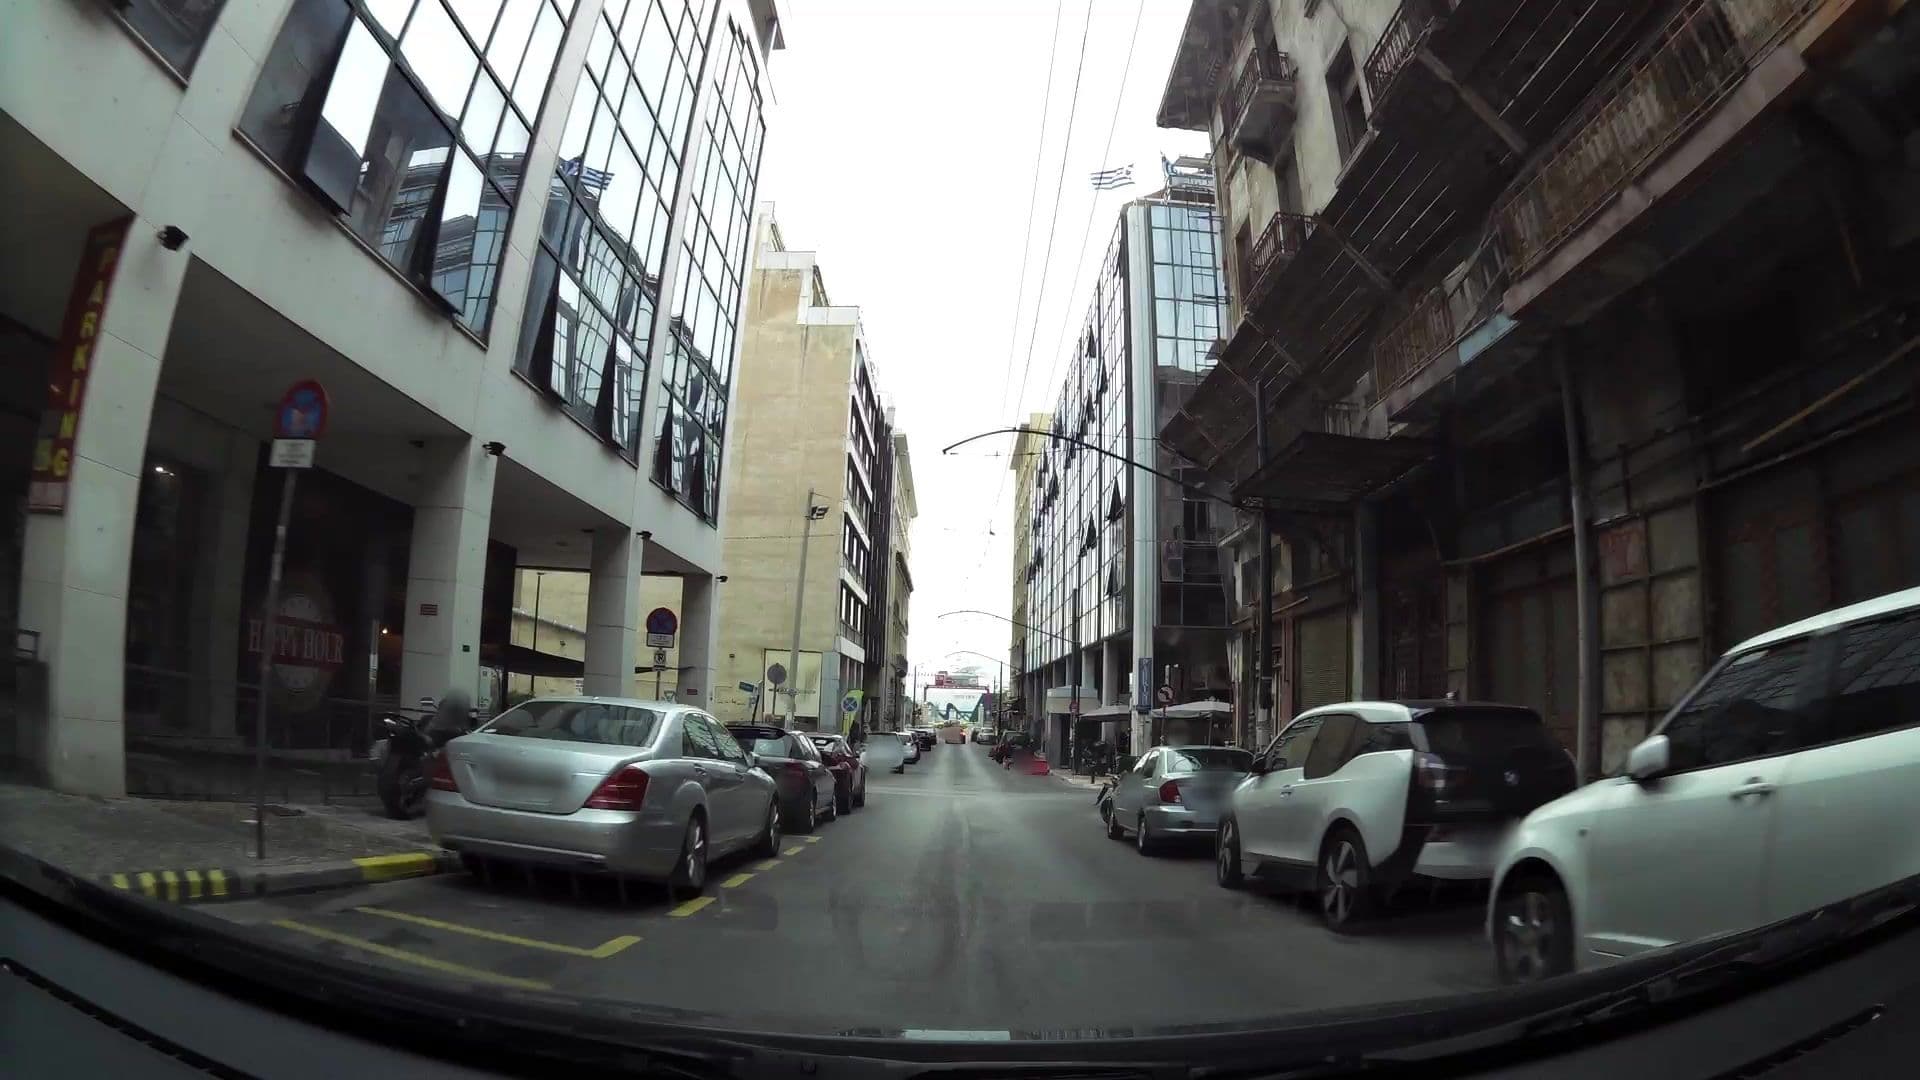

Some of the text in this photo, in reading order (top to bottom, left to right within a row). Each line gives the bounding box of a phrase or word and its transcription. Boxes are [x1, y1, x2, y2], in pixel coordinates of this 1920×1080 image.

[53, 247, 117, 478] PARKING
[248, 619, 345, 664] HPPY HOUR
